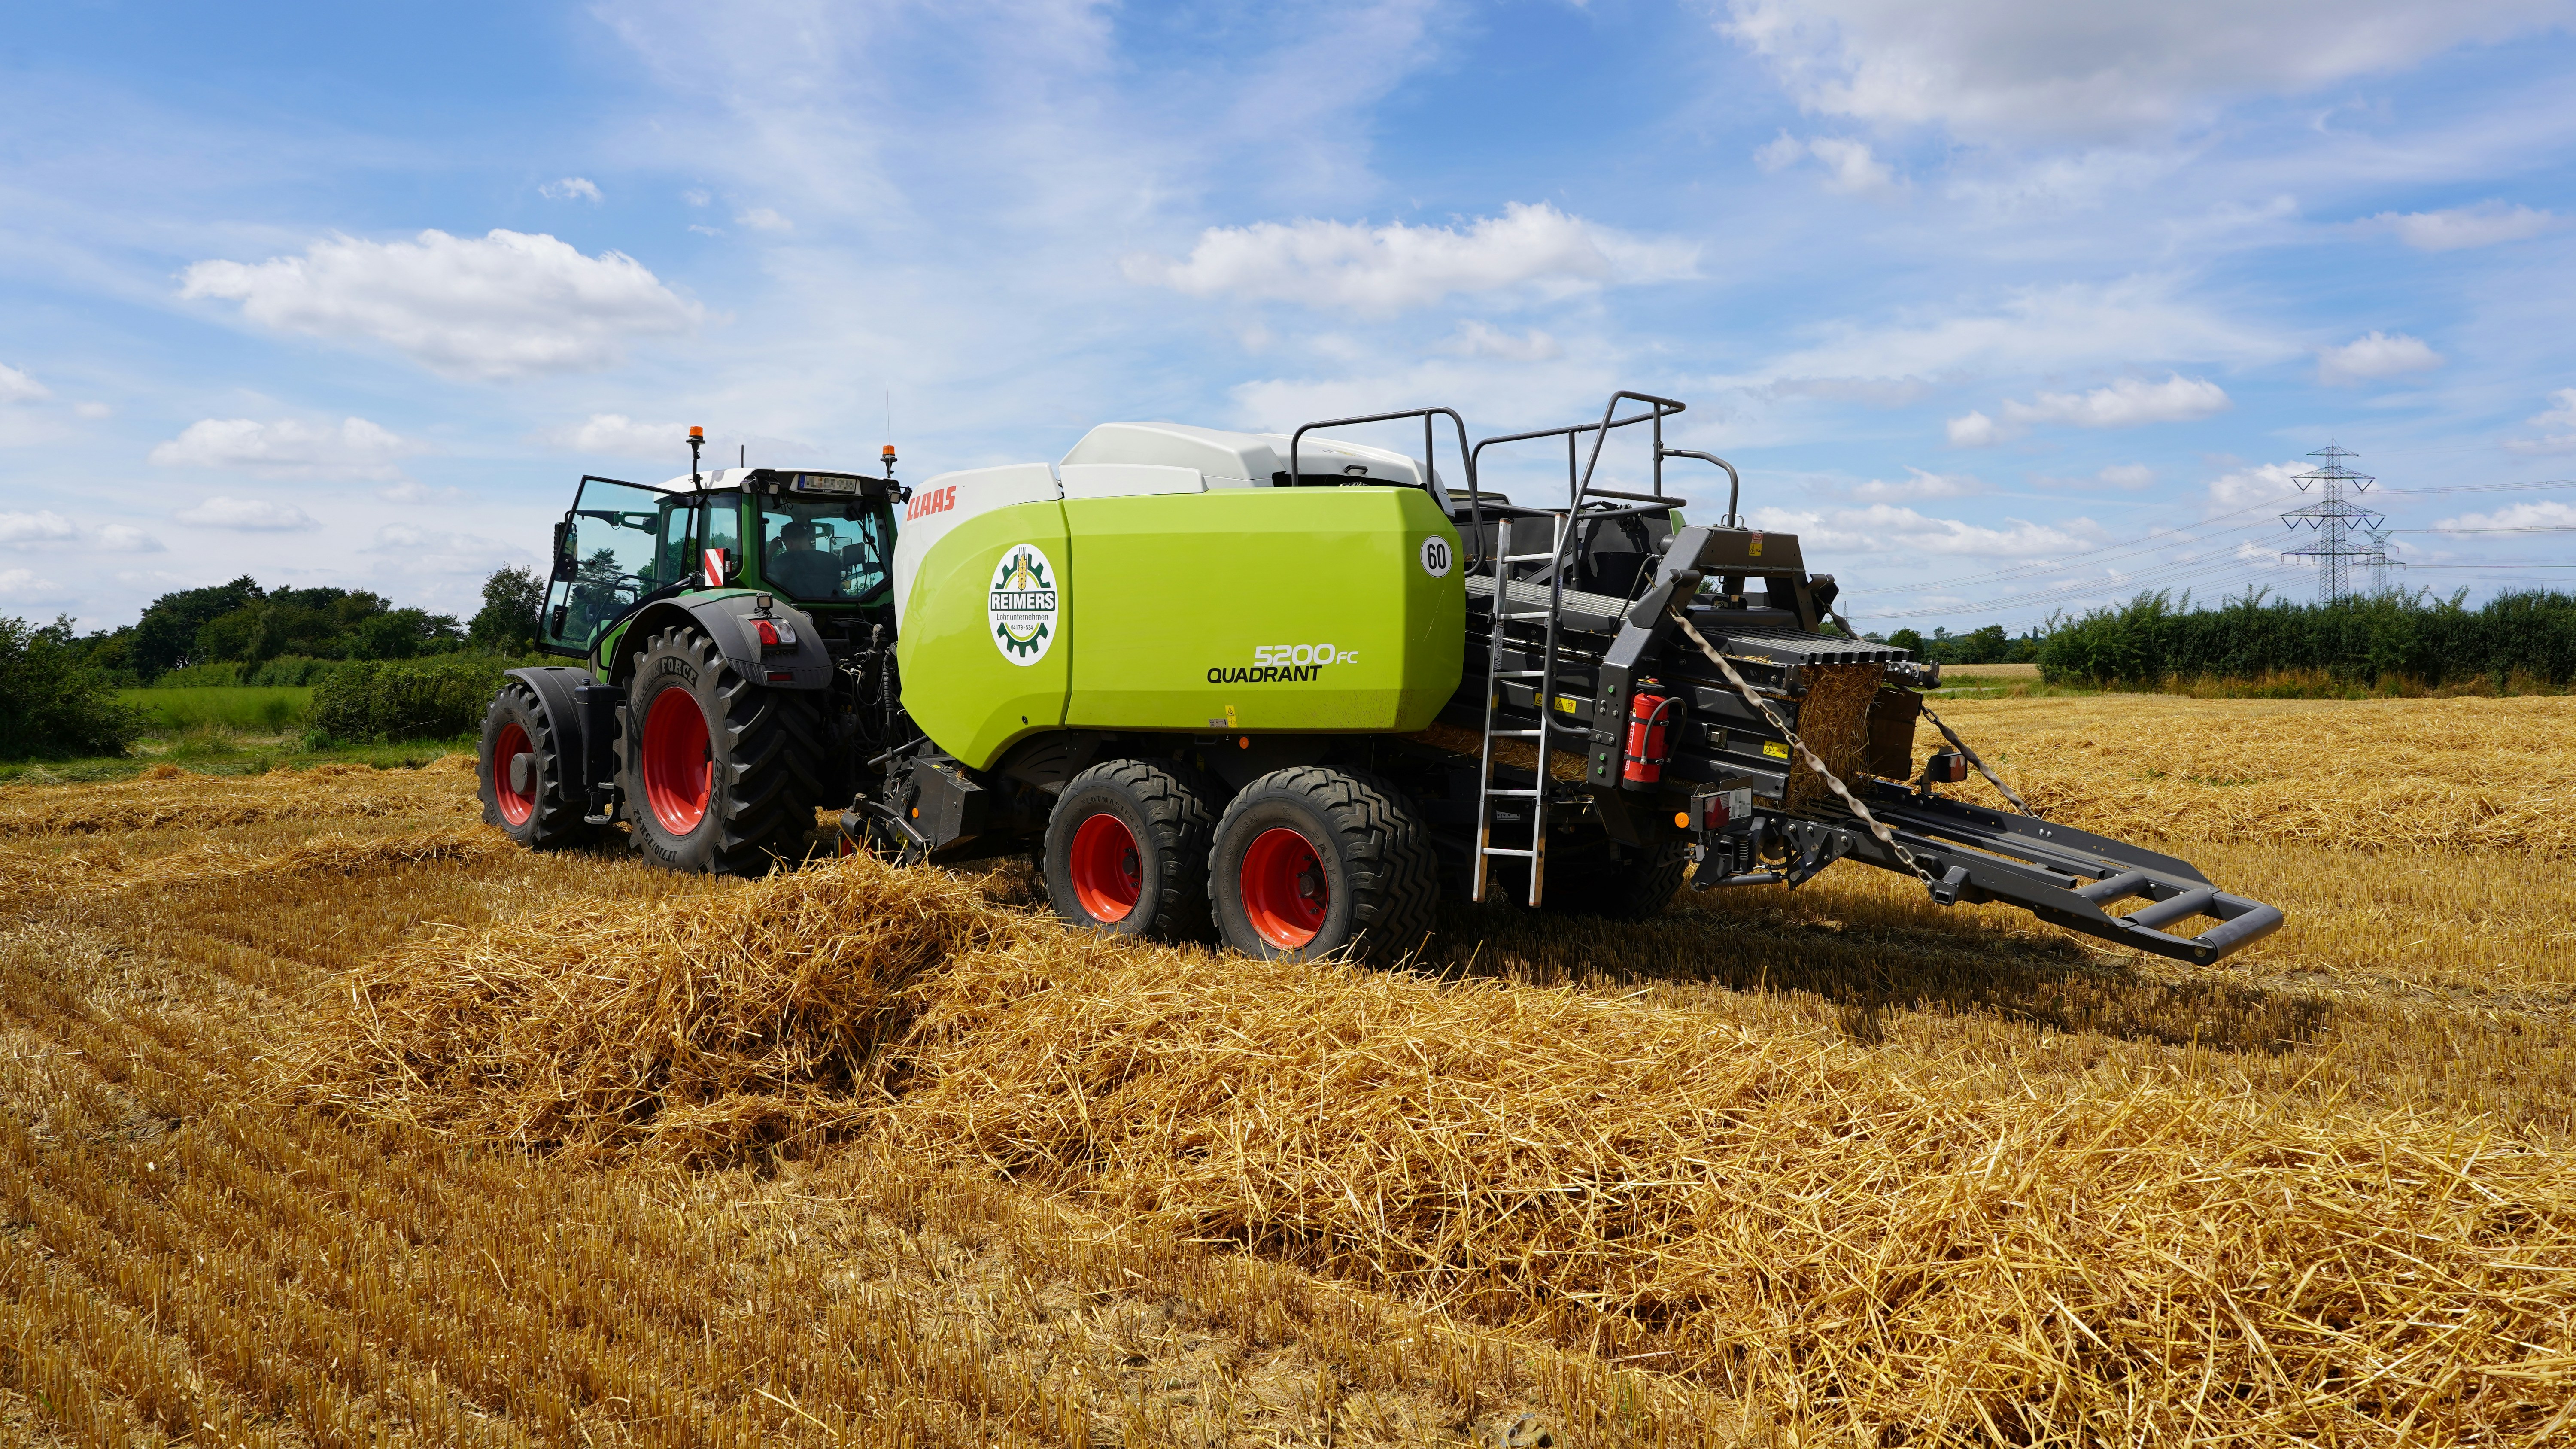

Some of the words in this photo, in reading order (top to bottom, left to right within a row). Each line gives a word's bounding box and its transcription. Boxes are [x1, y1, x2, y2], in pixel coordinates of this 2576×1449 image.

[907, 485, 957, 522] CLAAS
[1427, 544, 1446, 570] 60
[991, 592, 1054, 610] REIMERS
[661, 658, 697, 685] FORCE
[1207, 665, 1323, 683] QUADRANT
[1081, 796, 1135, 823] FLOTMASTER
[1222, 826, 1245, 909] FLOTMASTER
[1318, 843, 1339, 947] ALLIANCE
